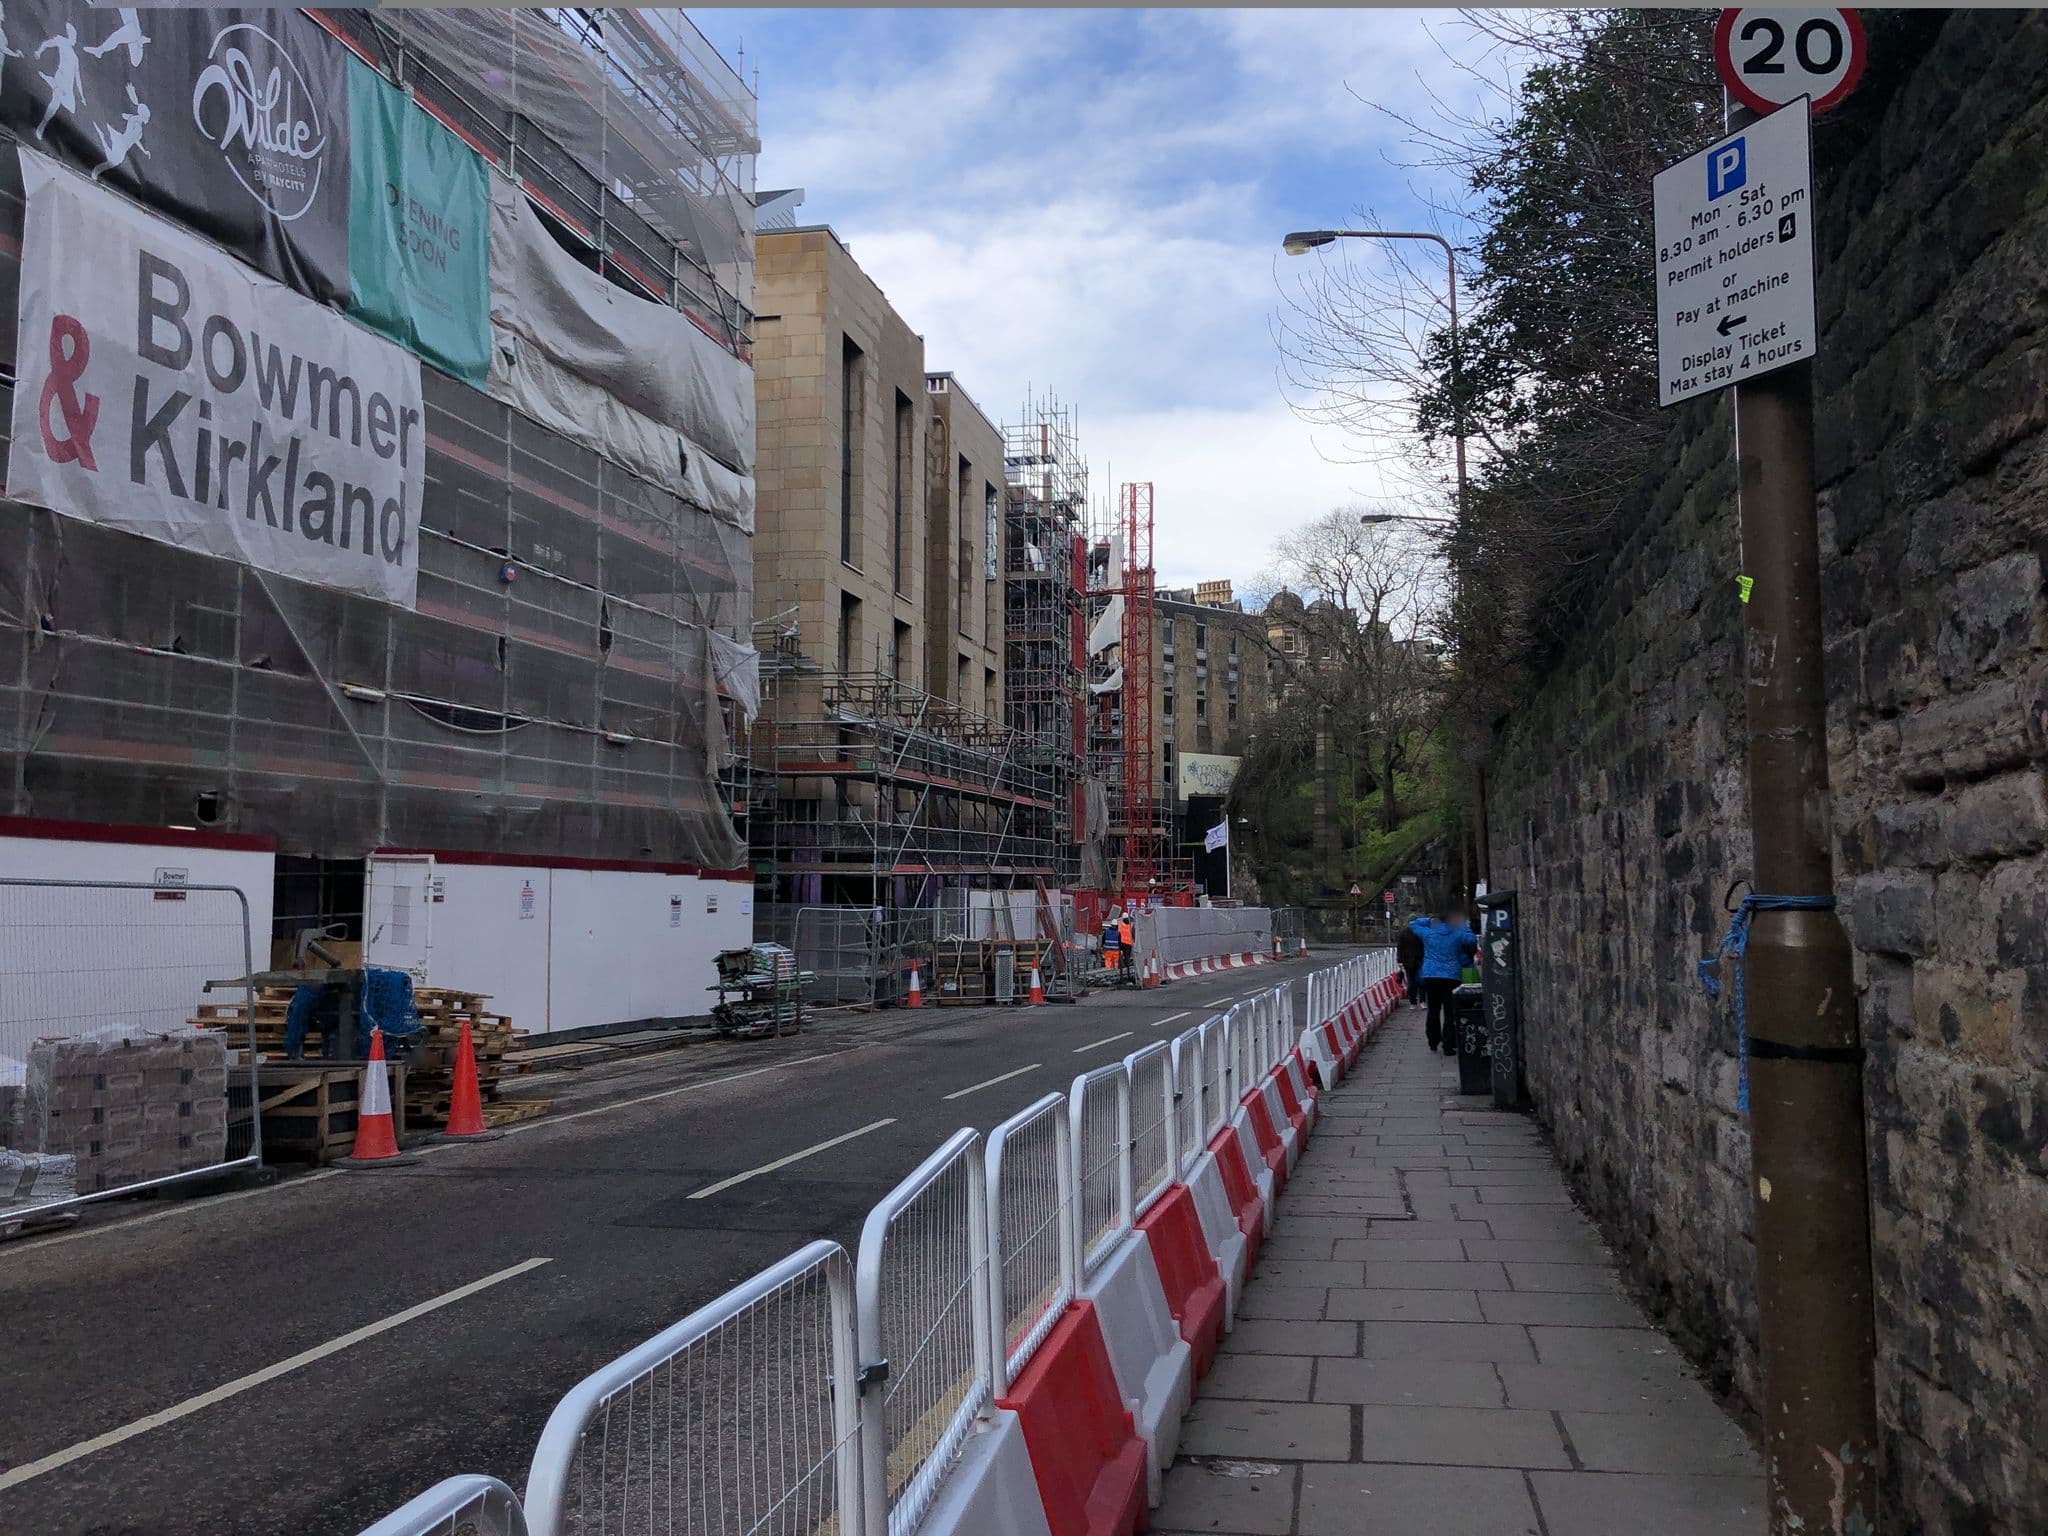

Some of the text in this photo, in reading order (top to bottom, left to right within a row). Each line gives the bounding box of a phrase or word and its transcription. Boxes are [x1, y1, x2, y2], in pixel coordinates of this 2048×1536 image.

[1740, 17, 1844, 75] 20
[192, 47, 327, 160] Wilde
[253, 169, 267, 182] BY
[1716, 147, 1740, 193] P
[1659, 236, 1693, 263] 8.30
[1698, 227, 1719, 246] am
[1737, 199, 1774, 228] 6.30
[1781, 187, 1805, 211] pm
[1690, 207, 1721, 230] Mon
[1739, 182, 1767, 207] Sat
[1668, 217, 1794, 287] Permit holders 4
[1722, 272, 1738, 289] or
[1676, 271, 1790, 327] Pay at machine
[137, 248, 420, 470] Bowmer
[1670, 338, 1803, 396] Max stay 4 hours
[1682, 321, 1787, 373] Display Ticket
[39, 314, 100, 472] &
[130, 375, 407, 567] Kirkland
[1495, 909, 1509, 928] P
